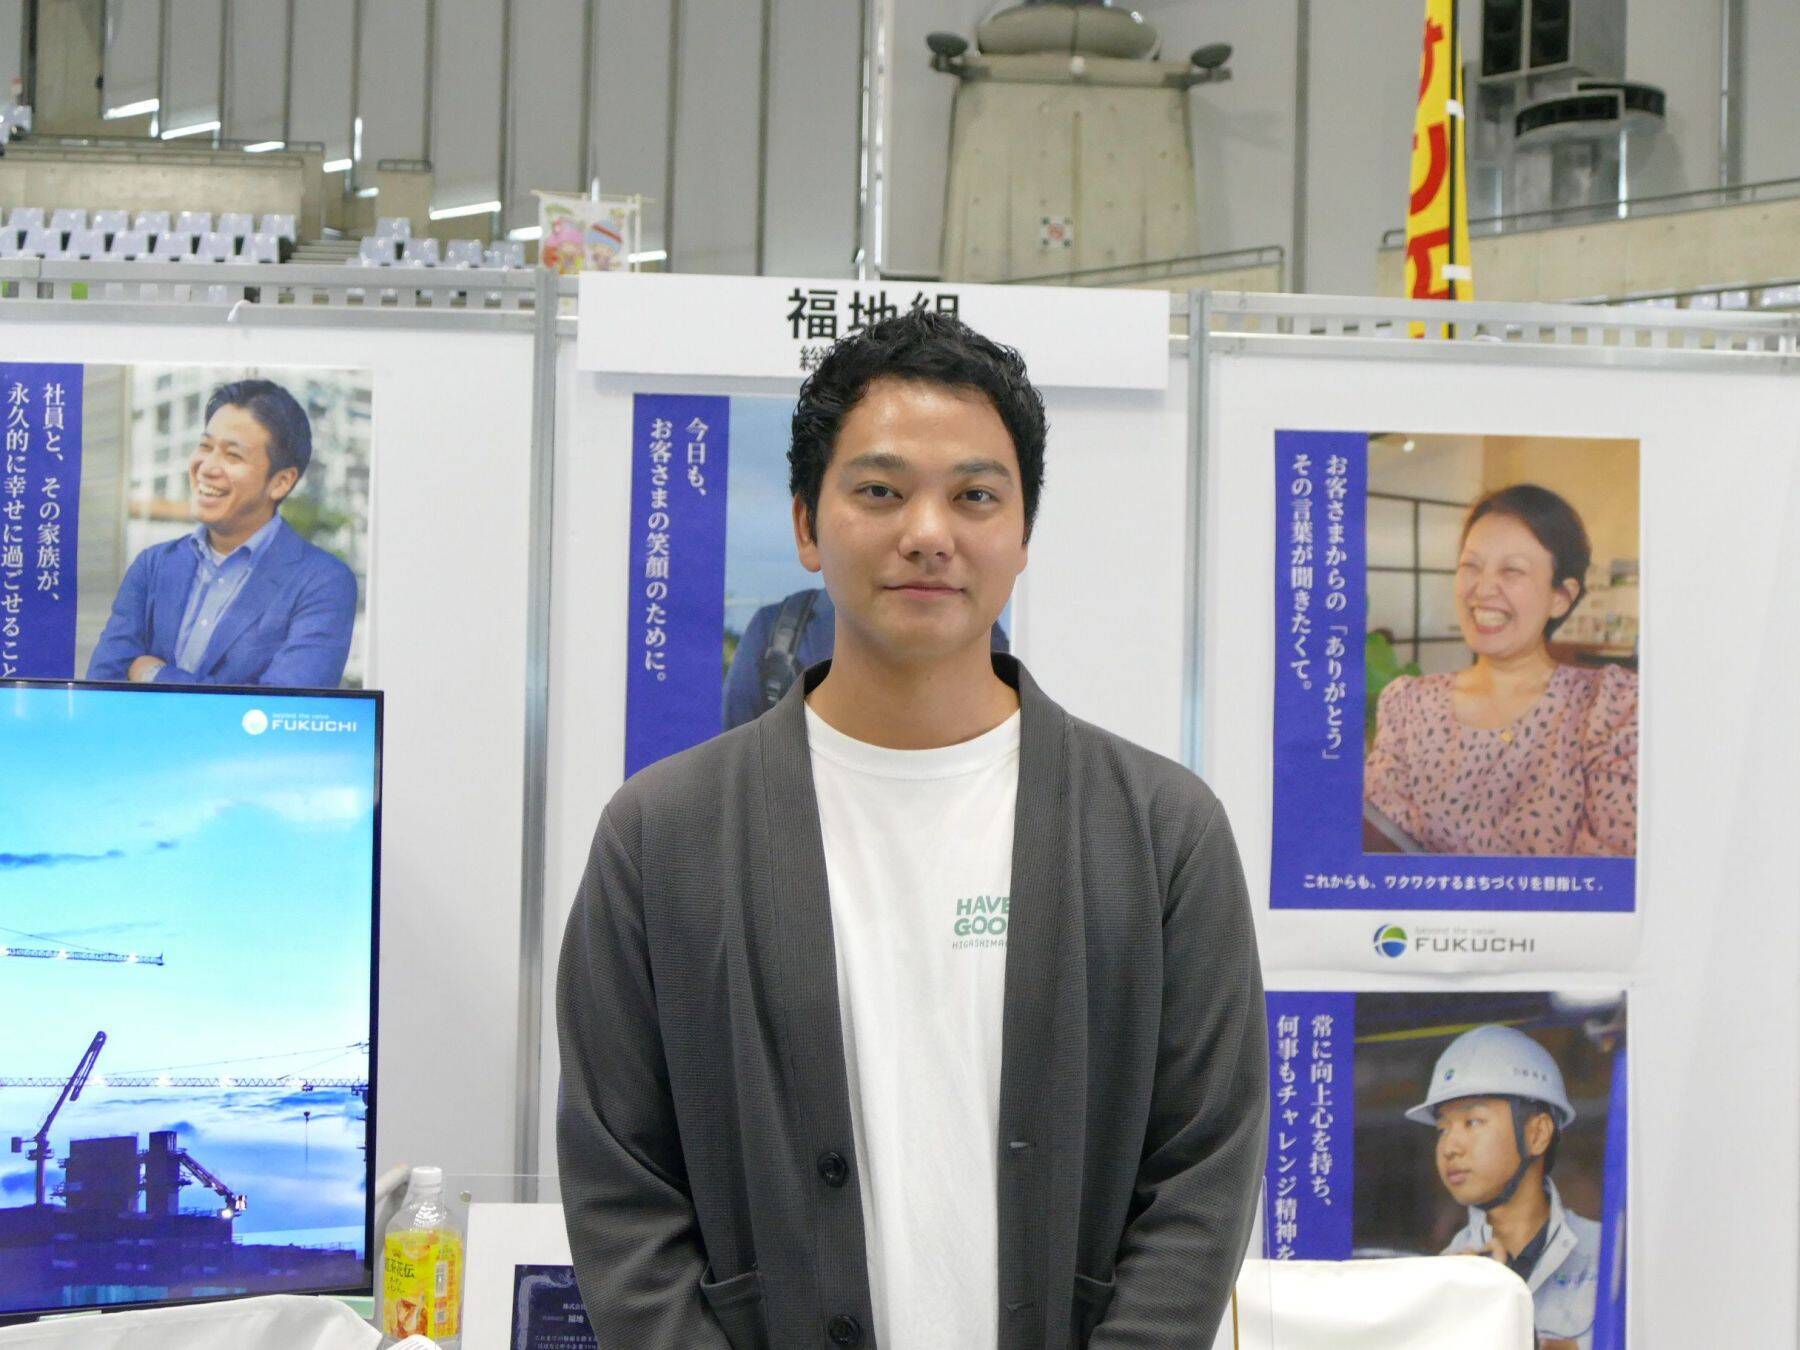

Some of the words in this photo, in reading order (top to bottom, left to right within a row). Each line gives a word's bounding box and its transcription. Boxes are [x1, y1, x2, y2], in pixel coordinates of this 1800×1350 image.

[686, 416, 709, 496] 今日も、
[37, 382, 66, 600] 社員と、その家族が、
[644, 417, 673, 682] お客さまの笑顔のために。
[1290, 455, 1313, 691] その言葉が聞きたくて。
[272, 719, 357, 732] FUKUCHI
[954, 916, 1007, 936] GOO
[956, 895, 1009, 916] HAVE
[952, 939, 1008, 951] HIGASHIMA
[1415, 937, 1535, 953] FUKUCHI
[1309, 1015, 1334, 1206] 常に向上心を持ち、
